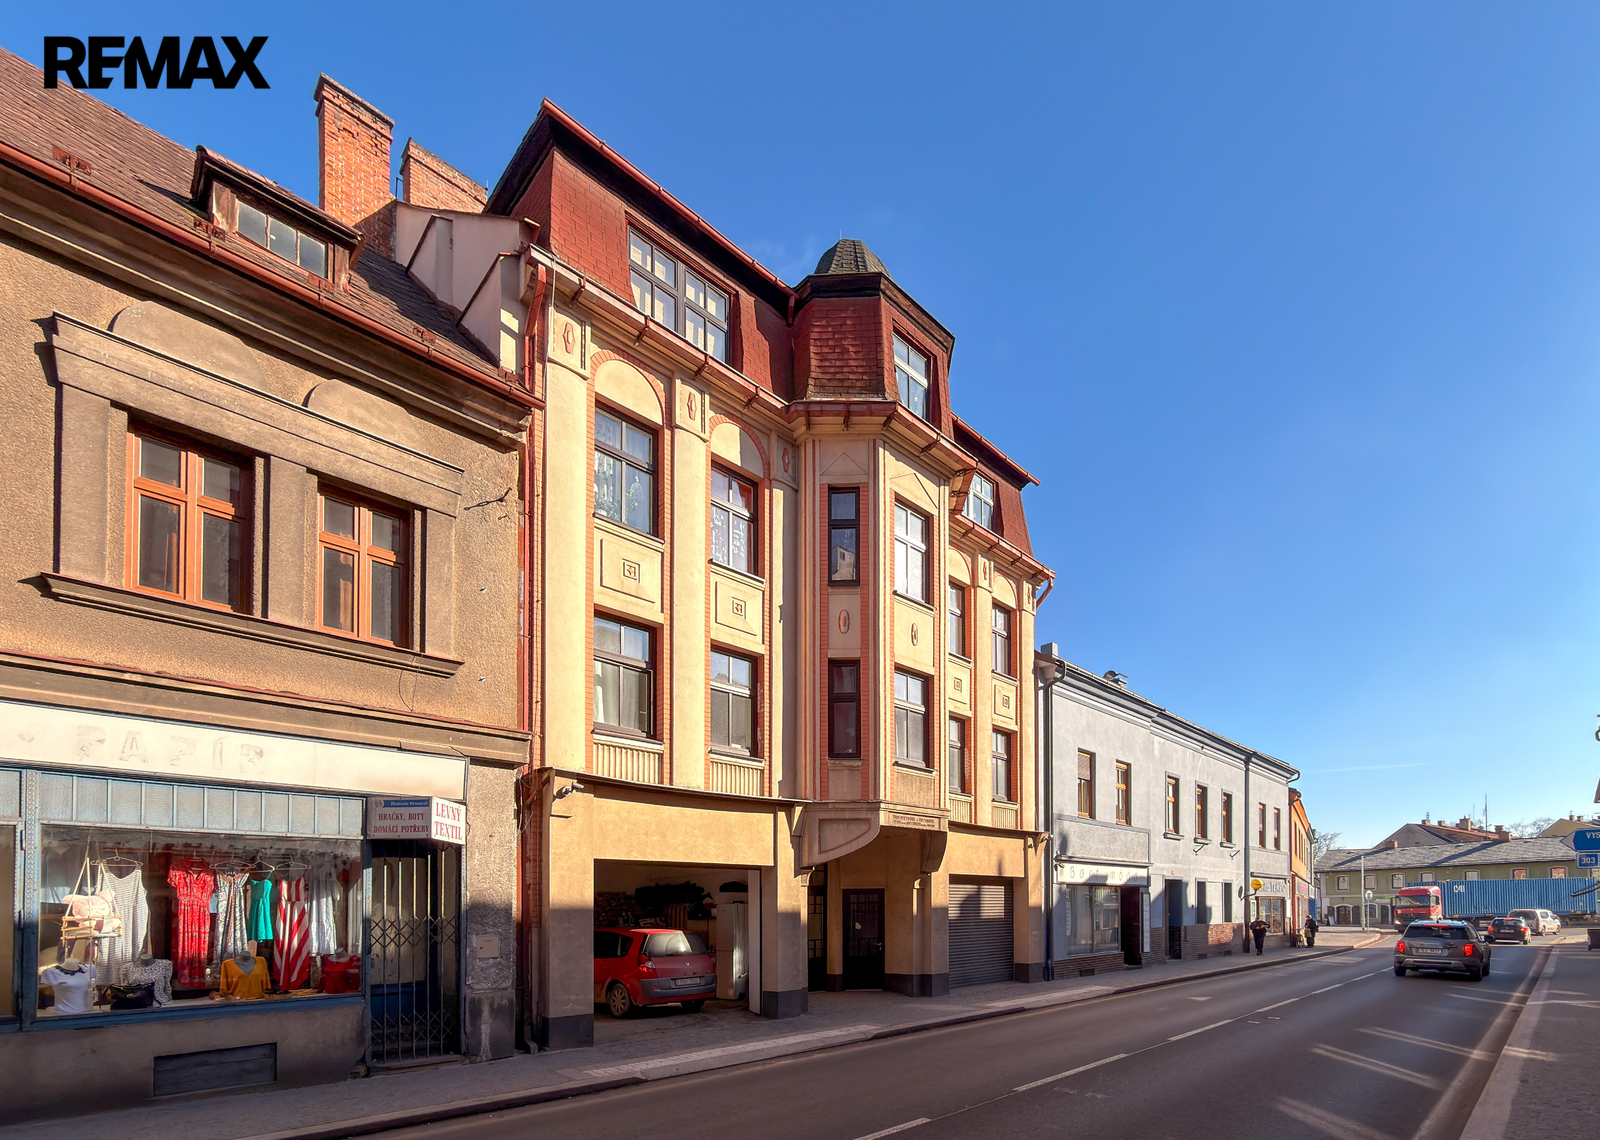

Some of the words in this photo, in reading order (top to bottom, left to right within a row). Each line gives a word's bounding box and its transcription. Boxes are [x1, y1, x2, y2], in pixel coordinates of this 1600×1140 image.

[378, 811, 406, 821] HRAČKY,
[408, 812, 425, 820] BOTY
[435, 802, 462, 822] LEVNÝ
[373, 824, 399, 833] DOMÁCÍ
[401, 823, 430, 833] POTŘEBY
[435, 820, 463, 840] TEXTIL
